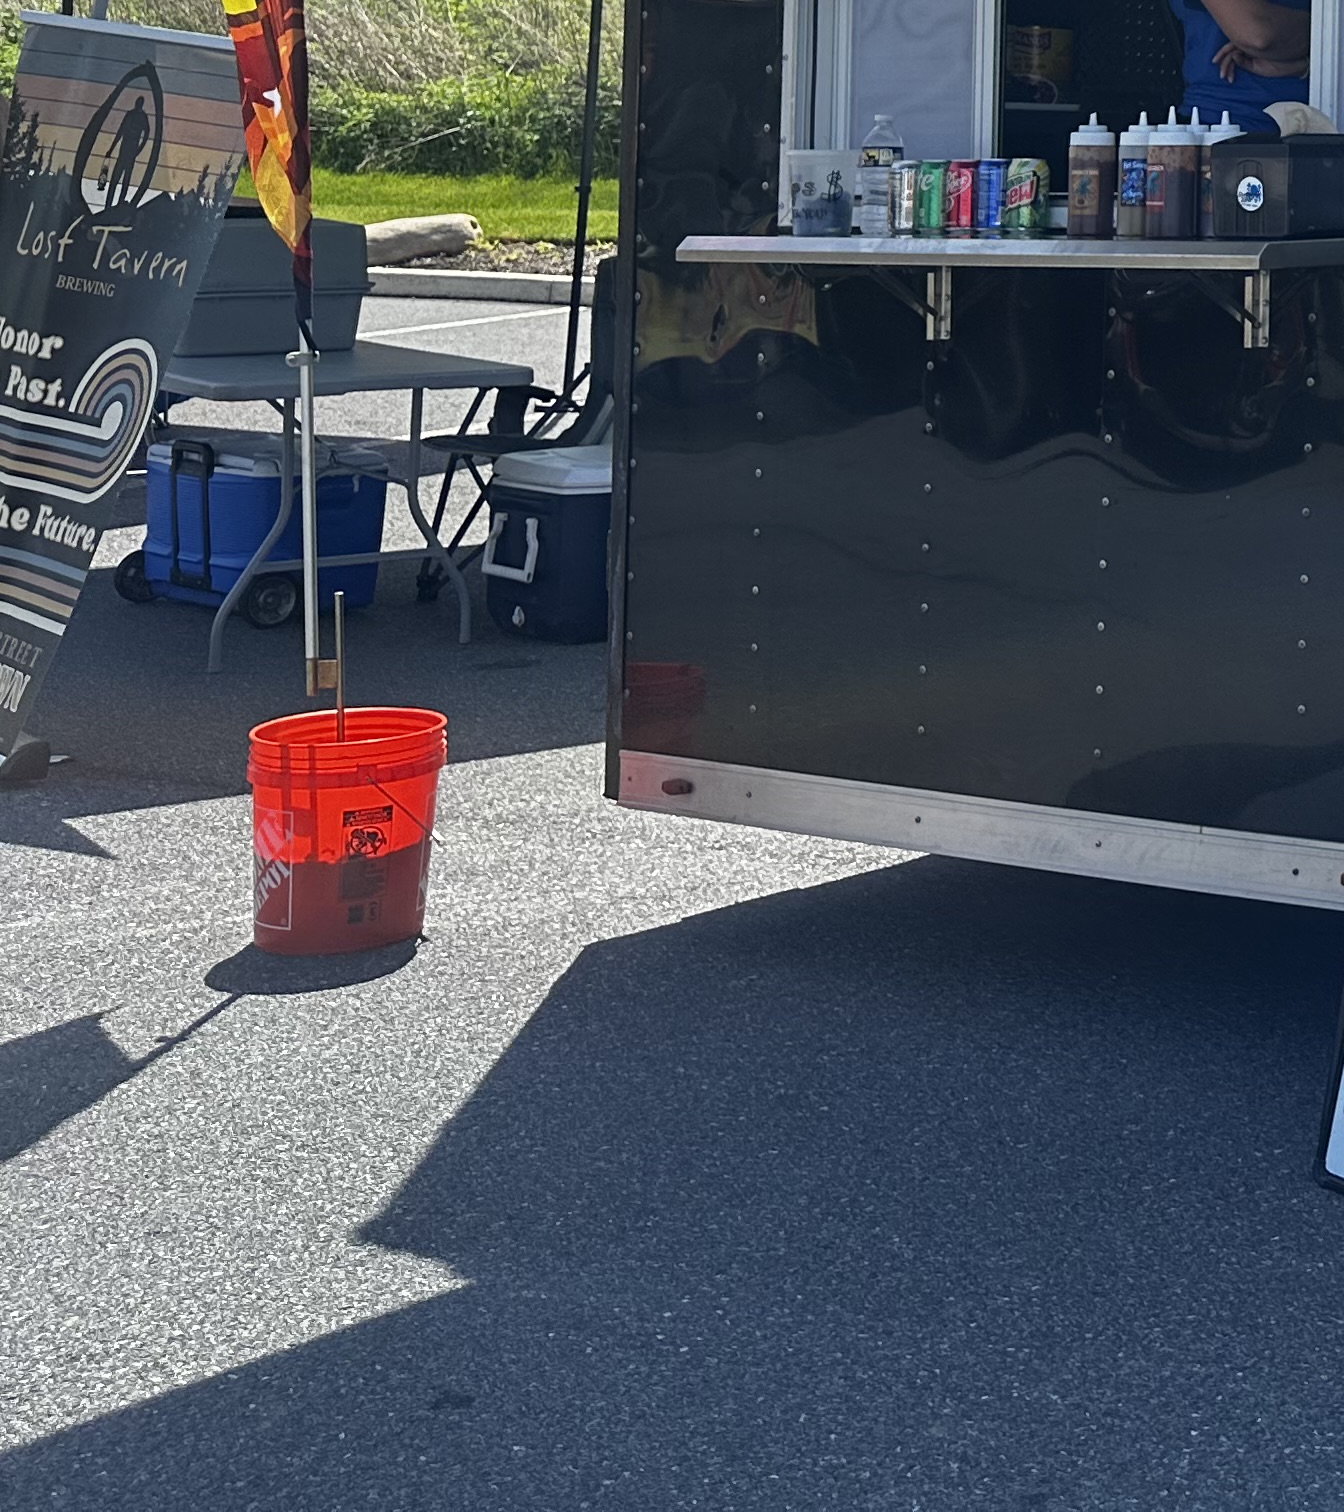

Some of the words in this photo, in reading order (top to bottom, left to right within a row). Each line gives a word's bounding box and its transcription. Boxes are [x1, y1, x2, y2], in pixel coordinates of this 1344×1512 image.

[16, 201, 85, 263] Lost
[90, 225, 188, 287] Tavern
[55, 274, 116, 298] BREWING
[4, 364, 66, 408] Past.
[0, 494, 31, 532] he
[32, 503, 96, 553] Future.
[0, 631, 43, 668] TREET
